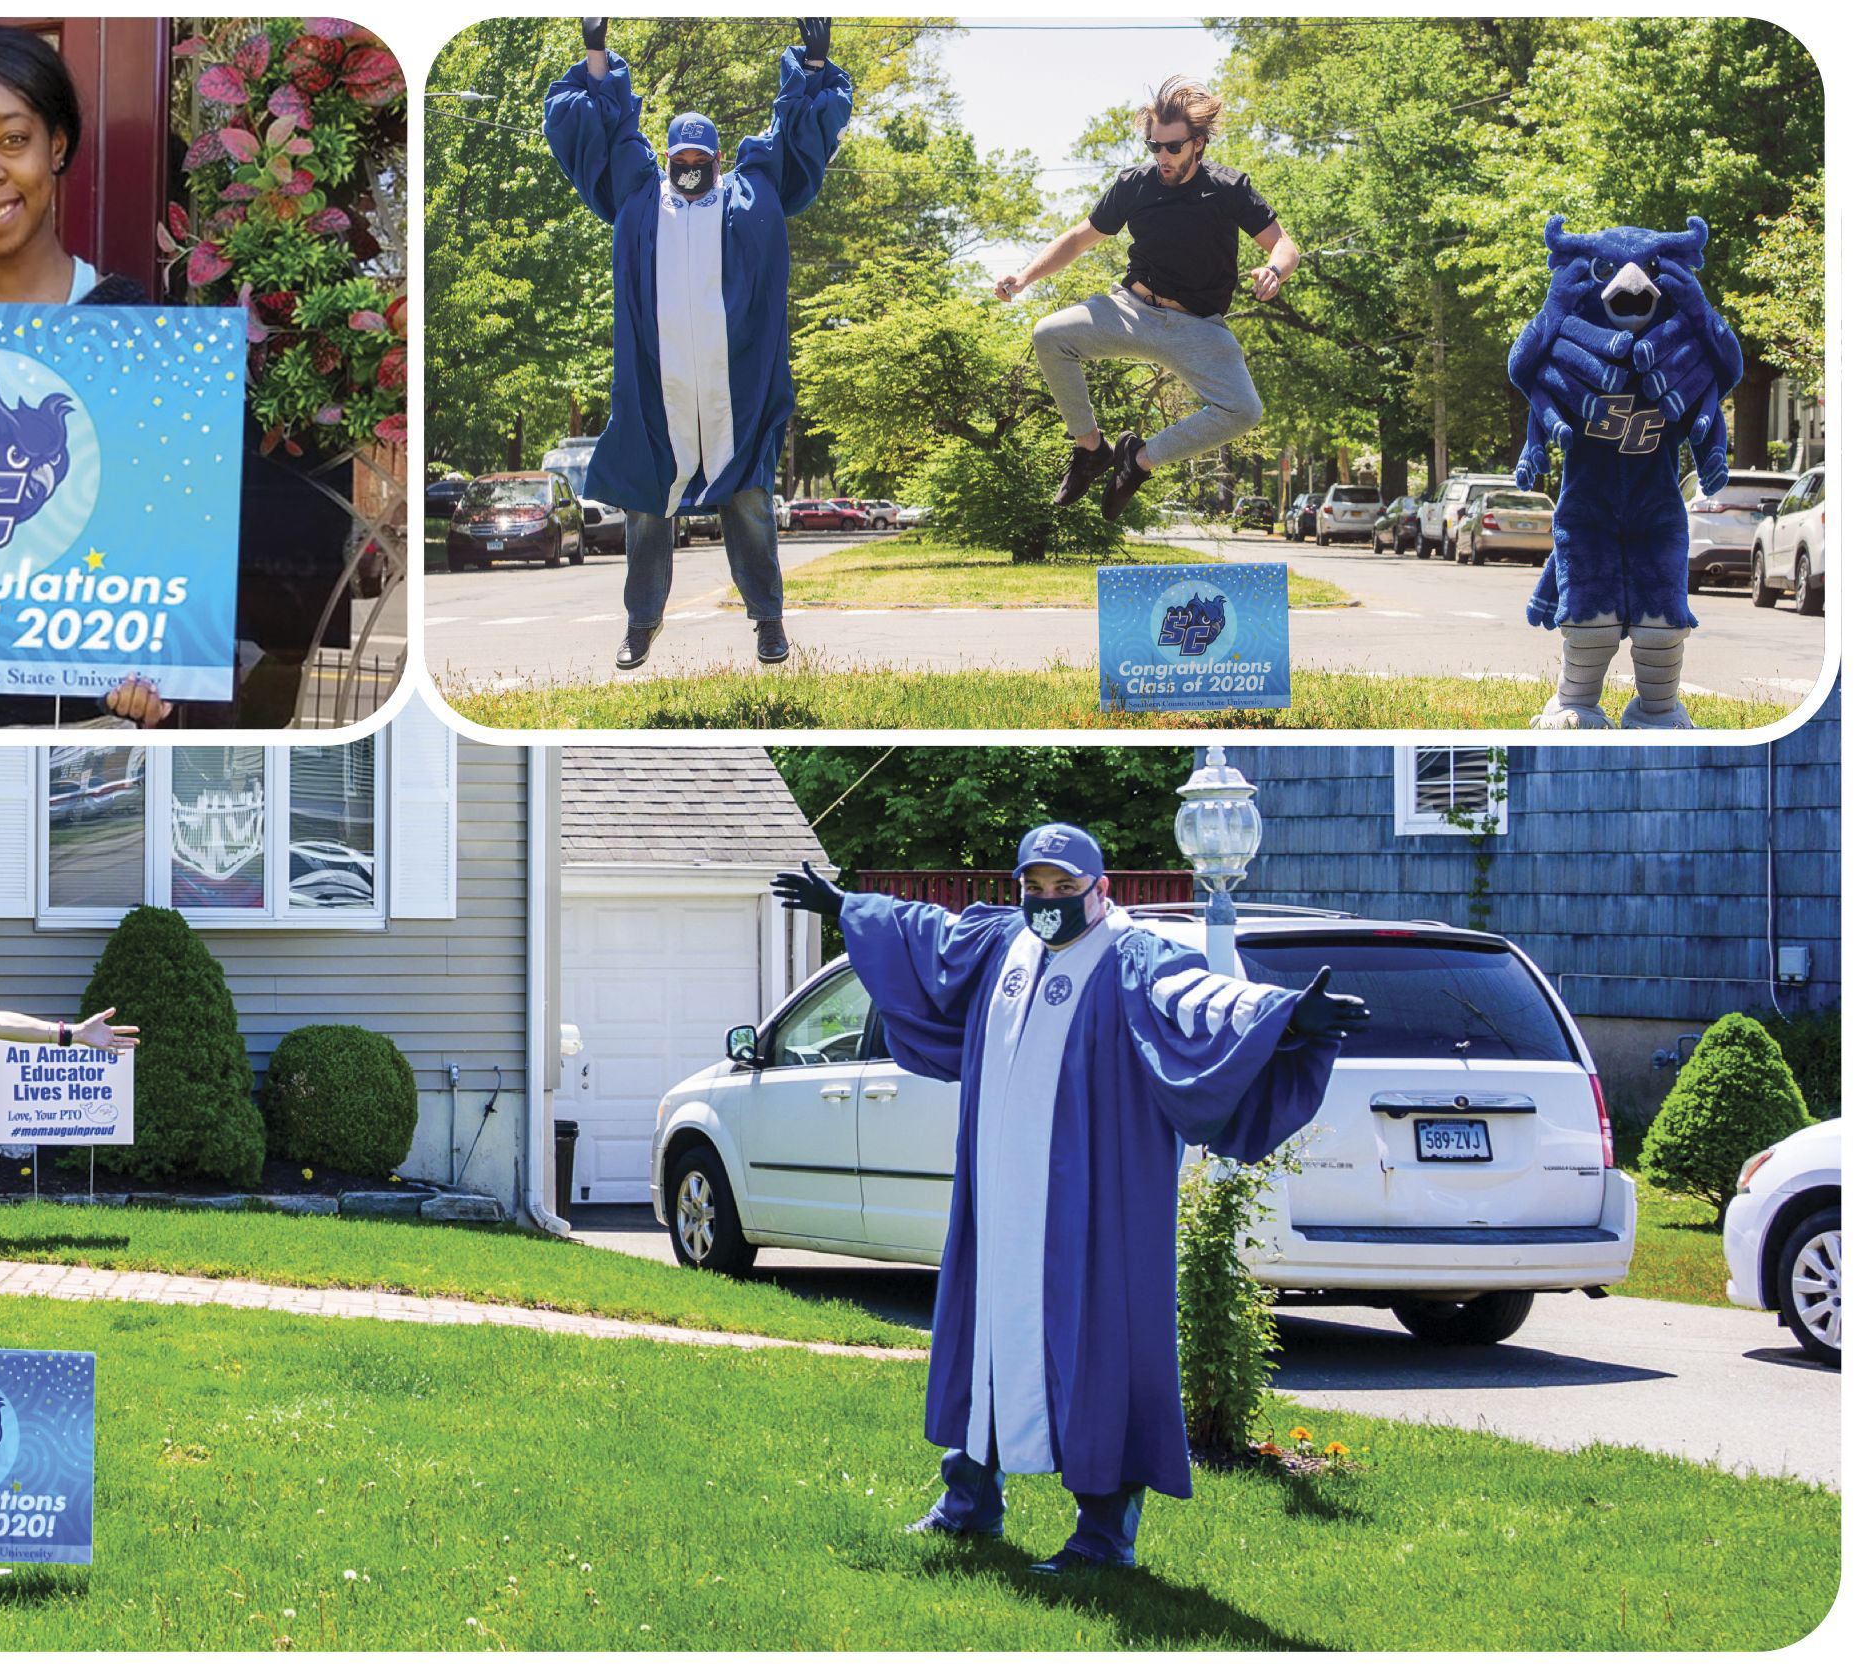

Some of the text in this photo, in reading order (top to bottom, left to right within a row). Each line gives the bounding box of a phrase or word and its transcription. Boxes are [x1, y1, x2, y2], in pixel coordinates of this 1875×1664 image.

[1584, 394, 1666, 454] SC
[12, 608, 168, 653] 2020!
[1157, 615, 1211, 657] SC
[6, 668, 56, 686] State
[1118, 656, 1272, 681] Congratulations
[1126, 674, 1265, 695] Class of 2020!
[1128, 701, 1161, 709] Southern
[1207, 699, 1224, 707] State
[1227, 697, 1264, 708] University
[6, 1046, 118, 1064] An Amazing
[20, 1065, 105, 1082] Educator
[13, 1083, 113, 1101] Lives Here
[8, 1109, 82, 1122] Love, Your PTO
[11, 1125, 116, 1137] #momauguinproud
[0, 1547, 55, 1560] University
